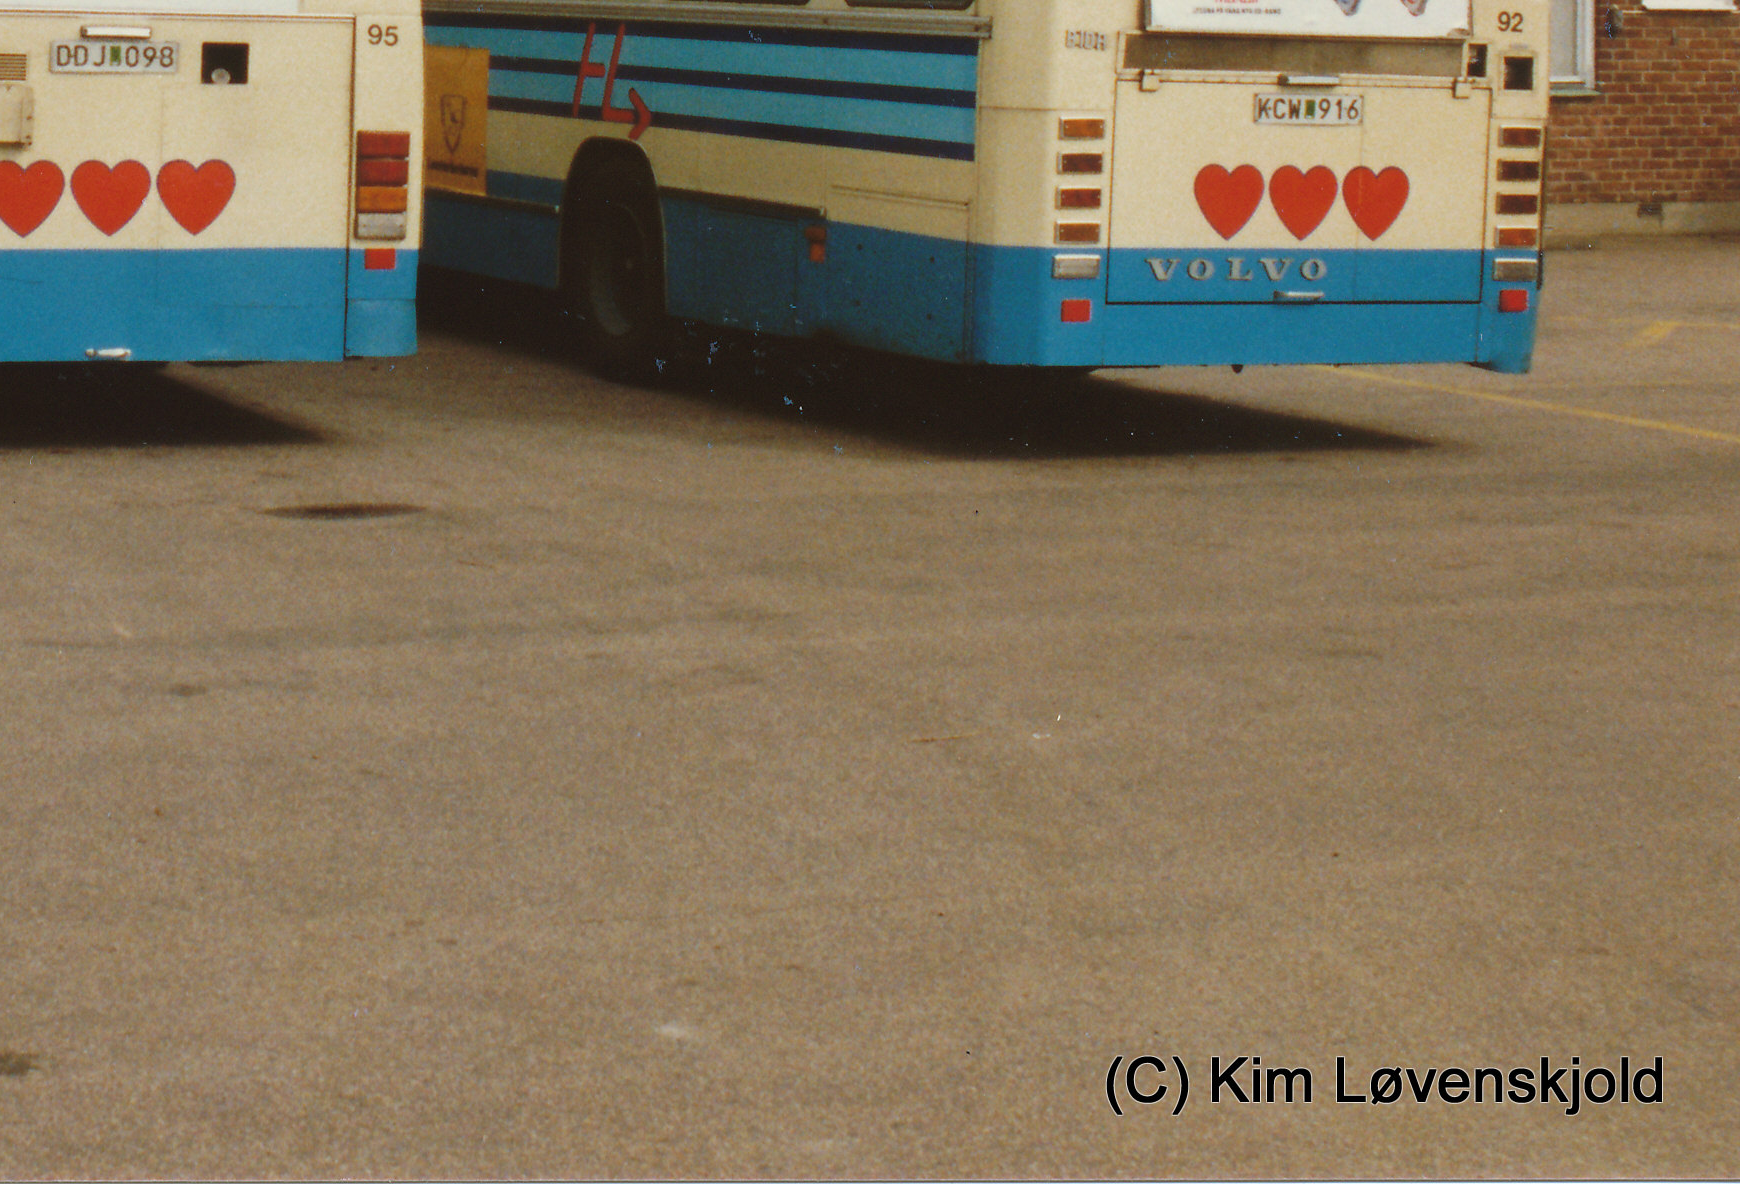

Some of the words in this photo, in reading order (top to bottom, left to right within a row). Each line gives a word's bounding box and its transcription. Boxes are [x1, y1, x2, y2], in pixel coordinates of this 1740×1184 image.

[1497, 10, 1524, 33] 92
[367, 23, 399, 47] 95
[56, 44, 107, 67] DDJ
[125, 45, 175, 68] 098
[1258, 97, 1301, 120] KCW
[1317, 97, 1359, 120] 916
[1144, 257, 1328, 282] VOLVO
